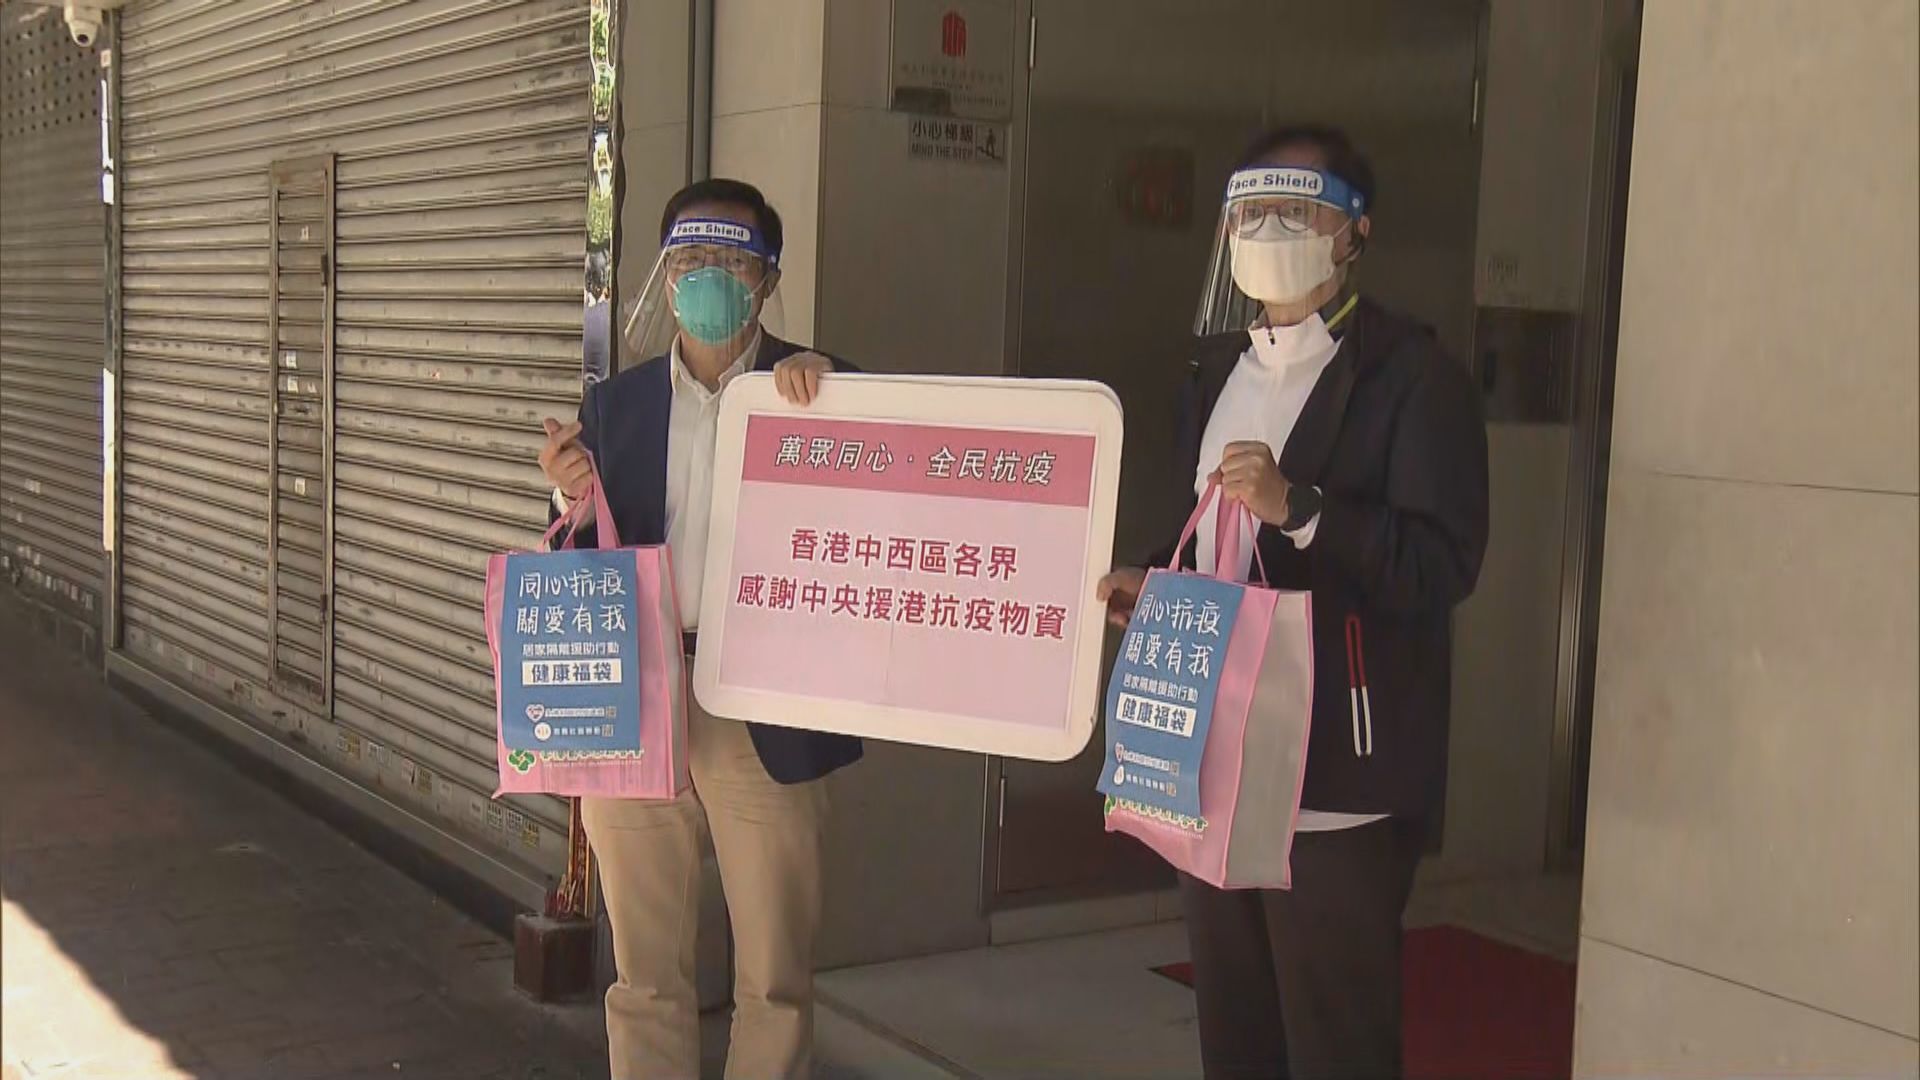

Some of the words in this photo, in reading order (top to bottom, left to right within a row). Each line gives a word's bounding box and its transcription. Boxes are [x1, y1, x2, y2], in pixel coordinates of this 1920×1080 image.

[1229, 177, 1258, 191] Face
[1263, 173, 1318, 190] Shield
[677, 224, 701, 235] Face
[705, 223, 744, 238] Shield
[790, 528, 1018, 582] 香港中西區各界
[519, 567, 627, 600] 同心抗疫
[516, 602, 626, 635] 關愛有我
[736, 573, 1067, 640] 感謝中央援港抗疫物資
[1137, 594, 1221, 637] 同心抗疫
[1124, 631, 1214, 679] 關愛有我
[531, 661, 612, 684] 健康福袋
[1121, 697, 1188, 732] 健康福袋
